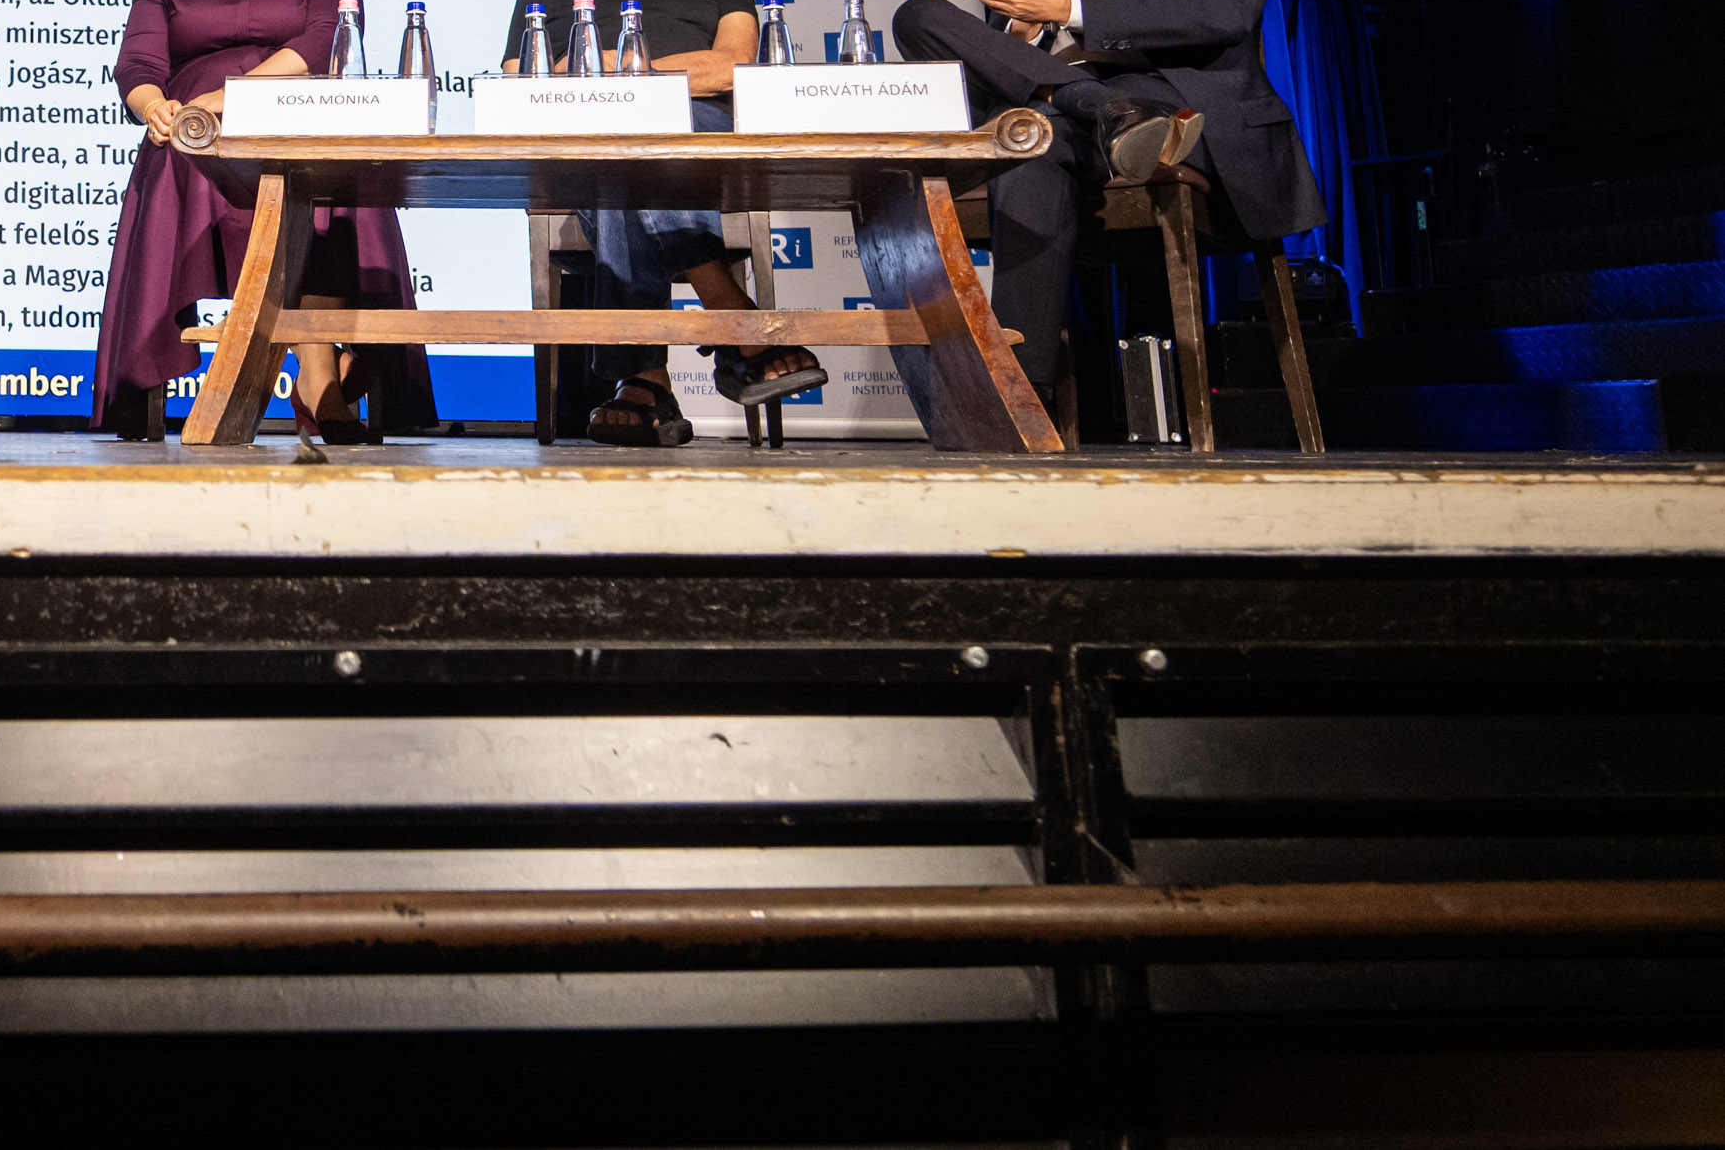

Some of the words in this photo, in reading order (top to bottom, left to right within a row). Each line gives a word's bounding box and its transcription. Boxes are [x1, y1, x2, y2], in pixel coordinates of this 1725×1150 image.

[7, 59, 93, 90] jogász,
[530, 91, 576, 104] MÉRŐ
[580, 90, 635, 103] LÁSZLÓ
[794, 82, 873, 97] HORVÁTH
[878, 81, 929, 96] ÁDÁM
[277, 94, 315, 105] KÓSA
[319, 93, 380, 105] MÓNIKA
[0, 102, 132, 125] matematik
[75, 147, 89, 165] a
[4, 180, 125, 210] digitalizá
[14, 220, 100, 246] felelős
[3, 268, 17, 286] a
[25, 264, 109, 293] Magya
[21, 304, 102, 328] tudom
[670, 372, 713, 382] REPUBLI
[843, 371, 901, 382] REPUBLIKO
[684, 384, 719, 395] INTÉZ
